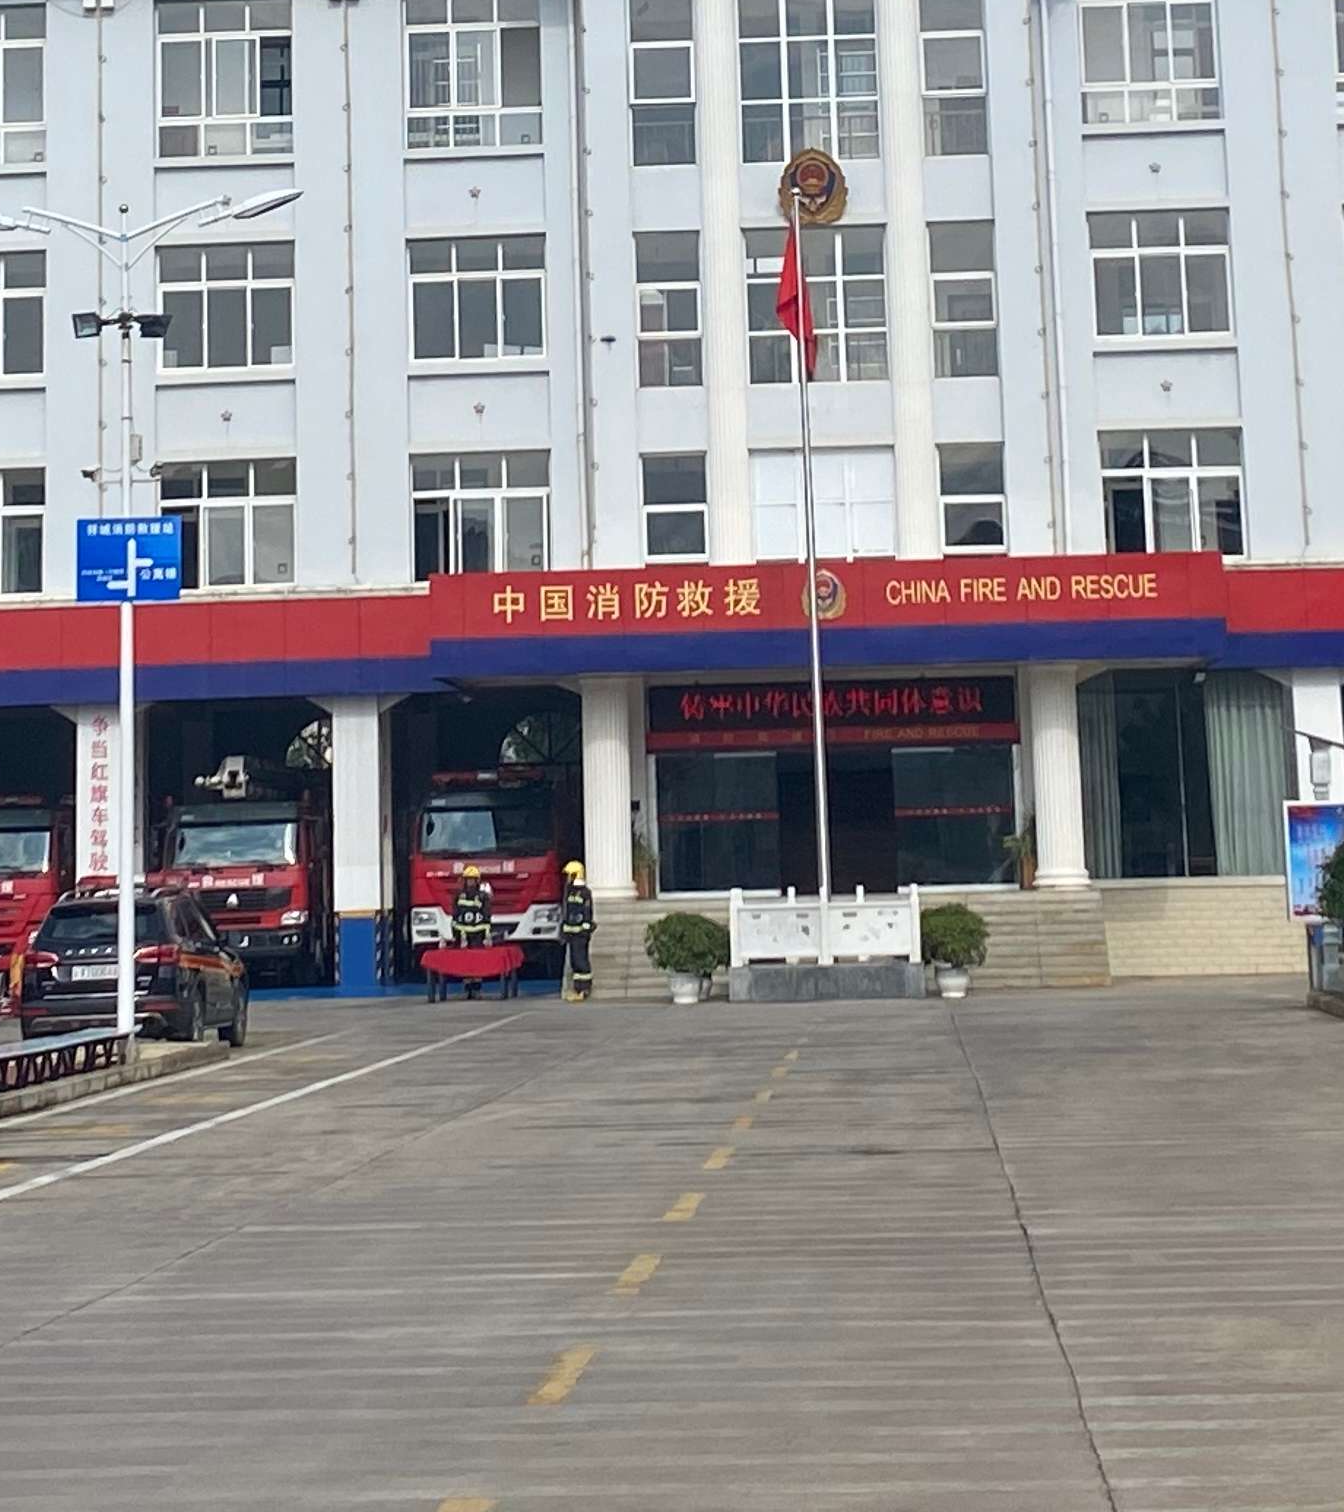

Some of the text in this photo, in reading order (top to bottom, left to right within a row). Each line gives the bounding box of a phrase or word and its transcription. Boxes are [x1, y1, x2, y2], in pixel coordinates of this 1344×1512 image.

[492, 578, 762, 624] 中国消防救援
[886, 573, 1159, 606] CHINA FIRE AND RESCUE
